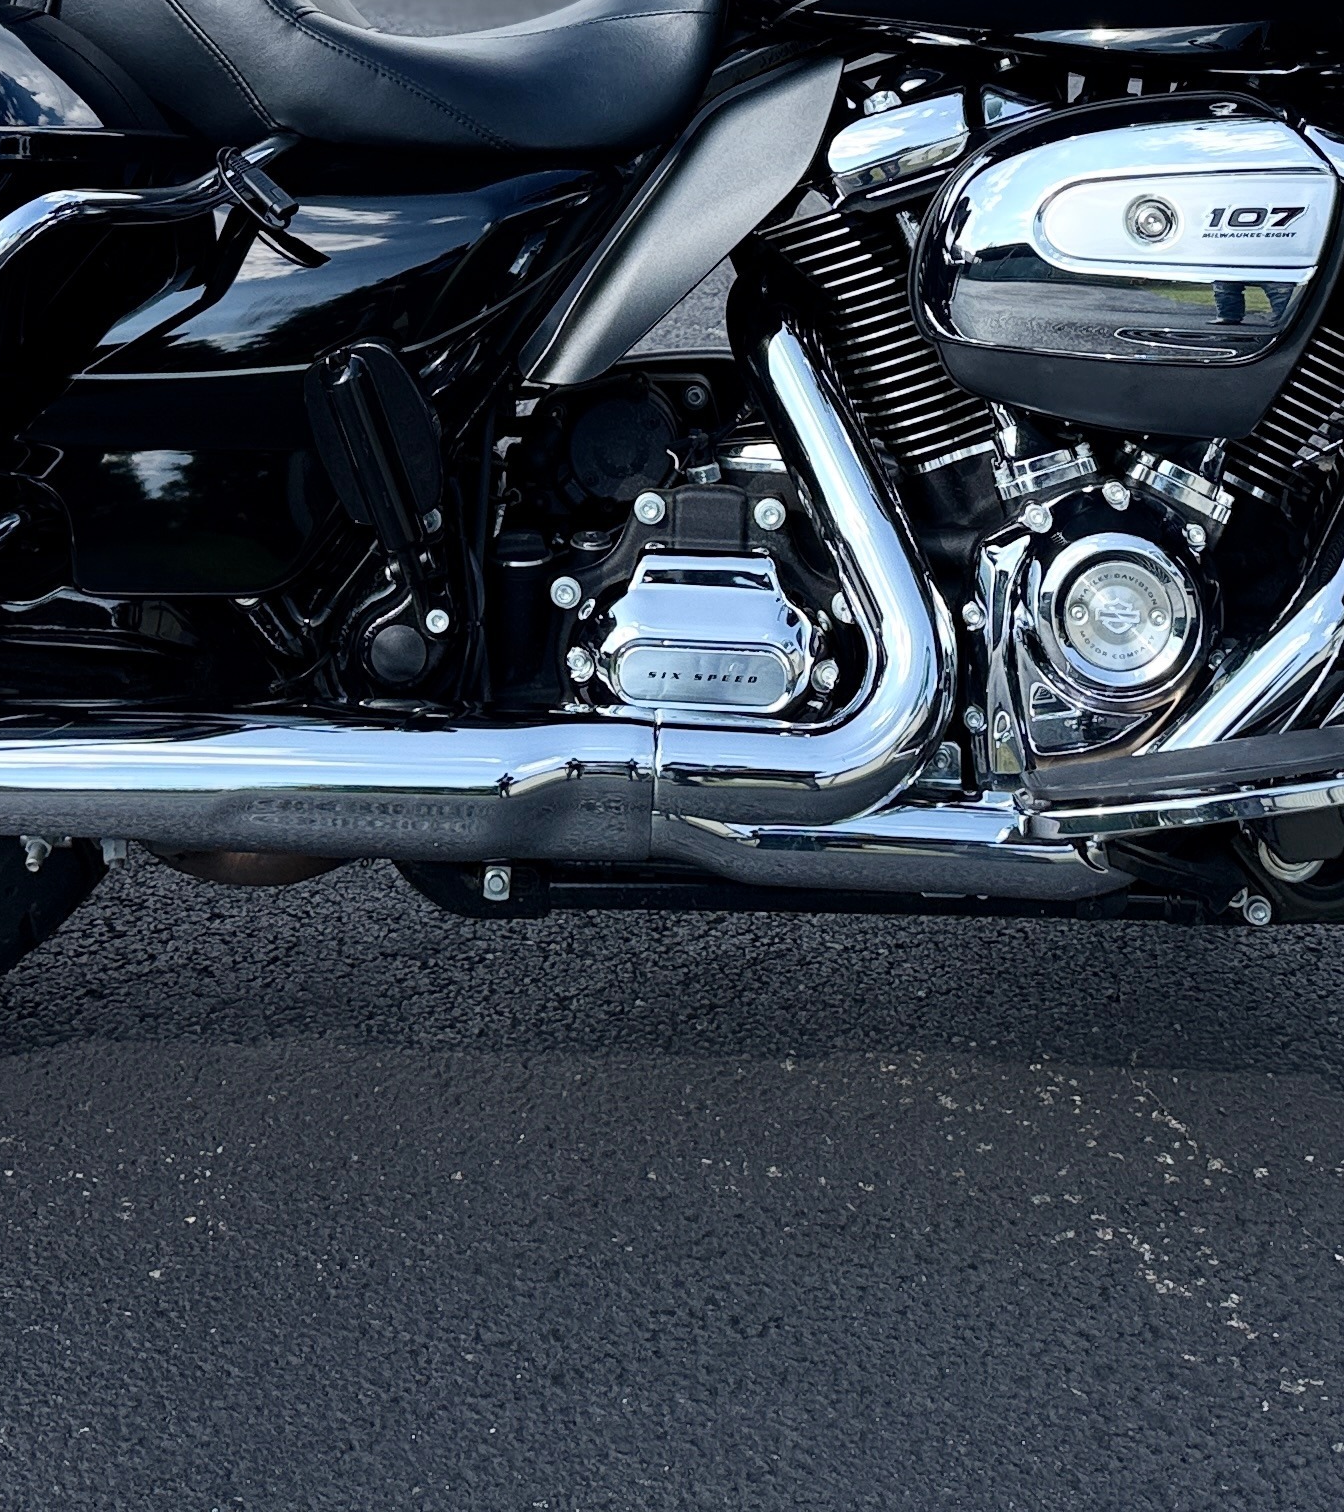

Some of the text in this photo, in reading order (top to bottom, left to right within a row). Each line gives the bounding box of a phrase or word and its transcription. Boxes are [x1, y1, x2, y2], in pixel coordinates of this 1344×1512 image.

[1206, 204, 1309, 230] 107
[1079, 630, 1108, 657] MOTOR
[647, 670, 758, 684] SIX SPEED
